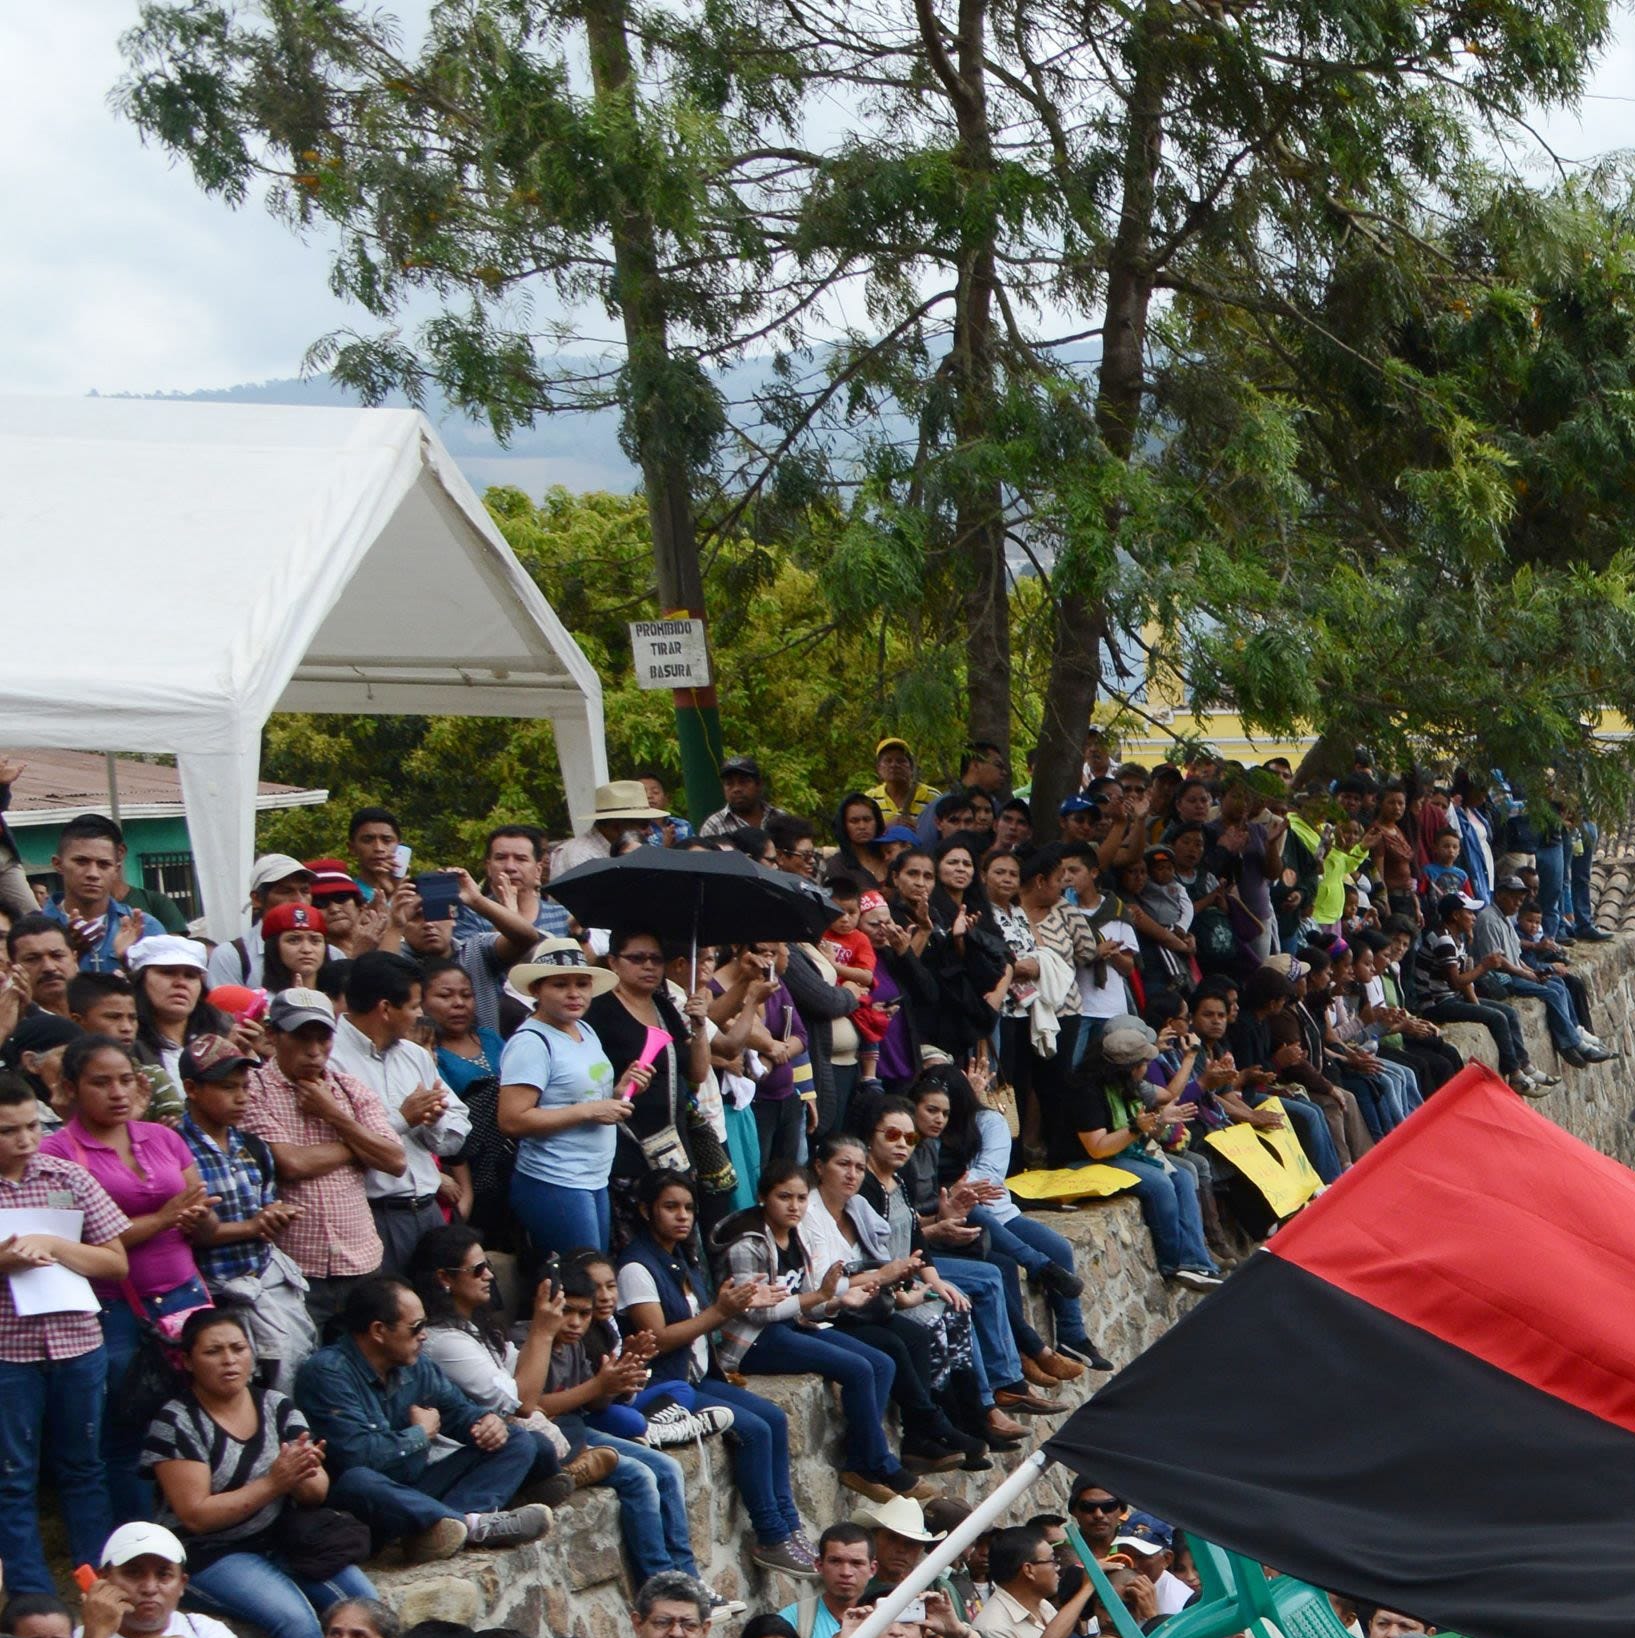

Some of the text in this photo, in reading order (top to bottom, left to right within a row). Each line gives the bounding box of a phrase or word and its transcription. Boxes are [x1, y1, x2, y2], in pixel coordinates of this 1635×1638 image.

[636, 622, 692, 637] PROHIBIDO
[650, 642, 681, 655] TIRAR
[650, 664, 692, 679] BASURA
